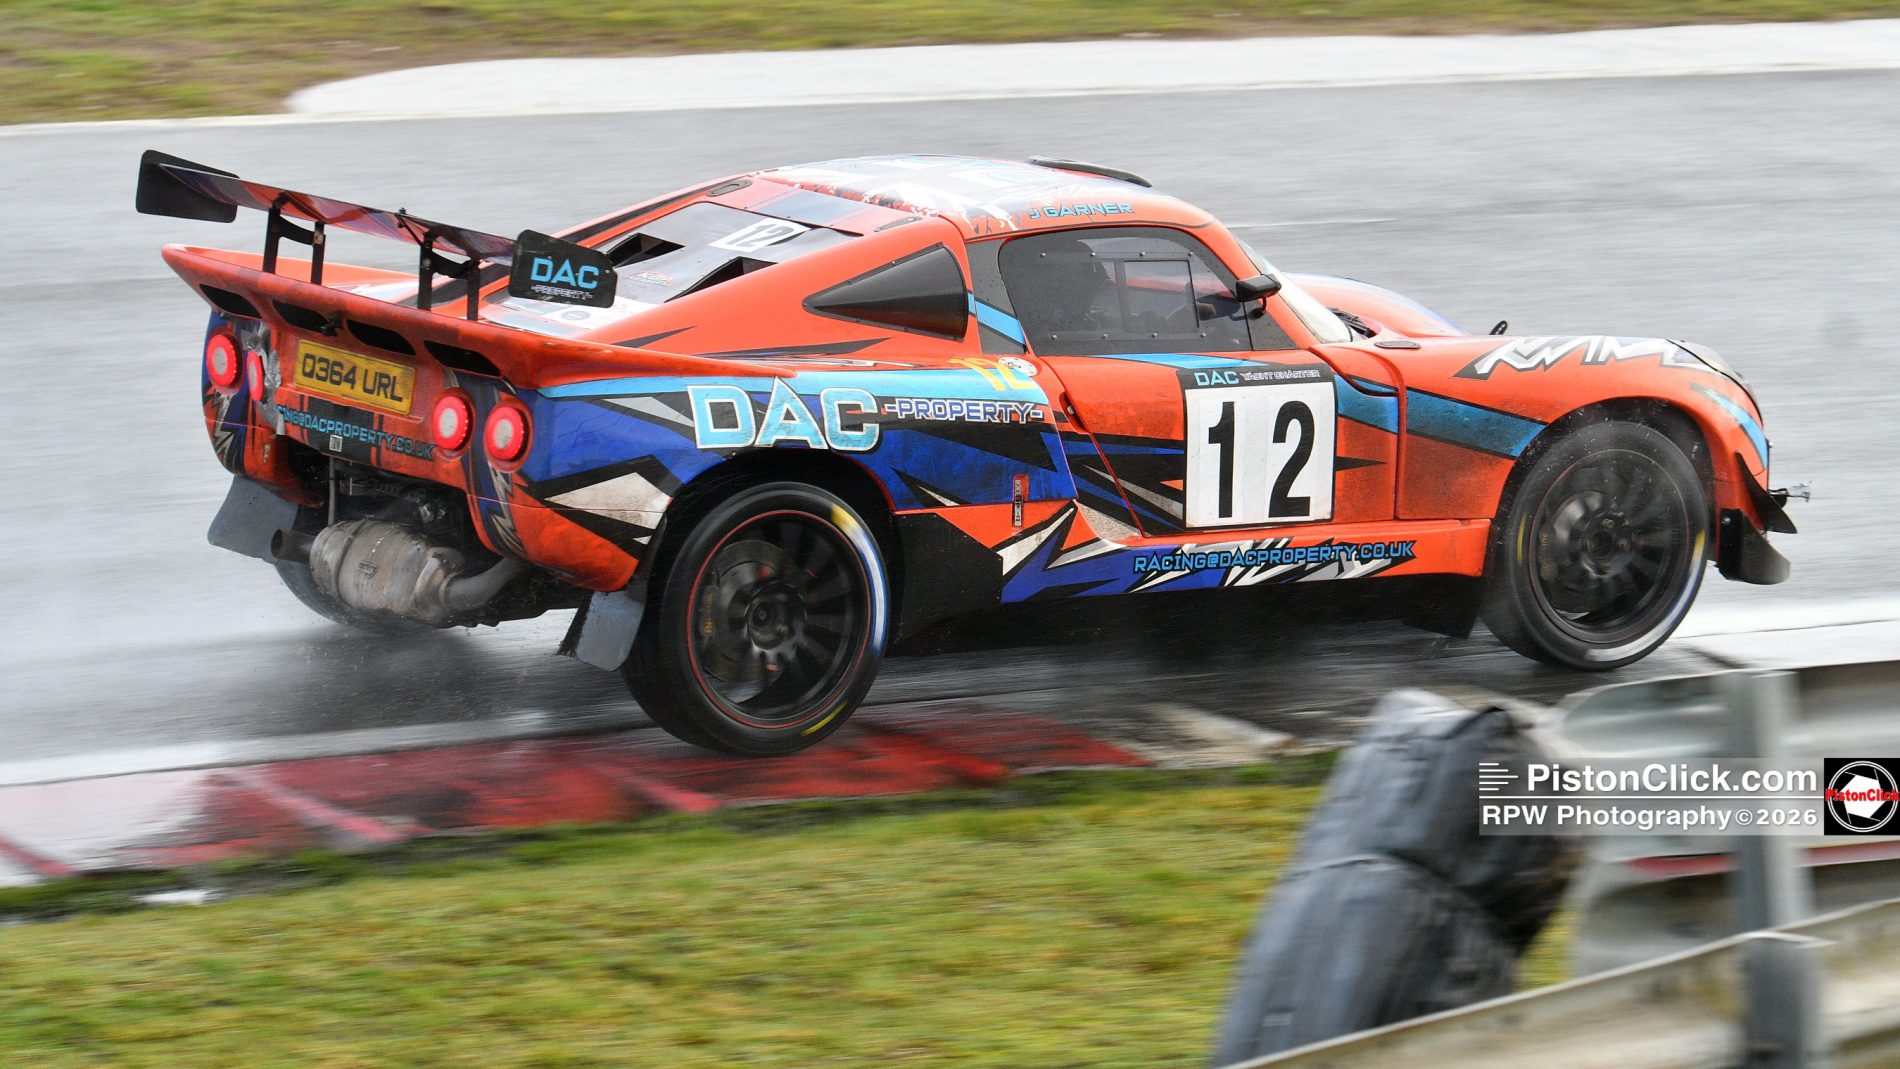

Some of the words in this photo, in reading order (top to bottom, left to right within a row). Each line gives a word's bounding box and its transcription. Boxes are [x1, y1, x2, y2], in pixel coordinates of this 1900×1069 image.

[1029, 207, 1040, 219] J
[1042, 203, 1134, 217] GARNER
[726, 223, 795, 248] 12
[530, 257, 600, 290] DAC
[361, 368, 404, 403] URL
[1193, 370, 1240, 386] DAC
[687, 376, 880, 452] DAC
[1208, 400, 1315, 518] 12
[1134, 540, 1416, 572] RACING@DACPROPERTY.CO.UK
